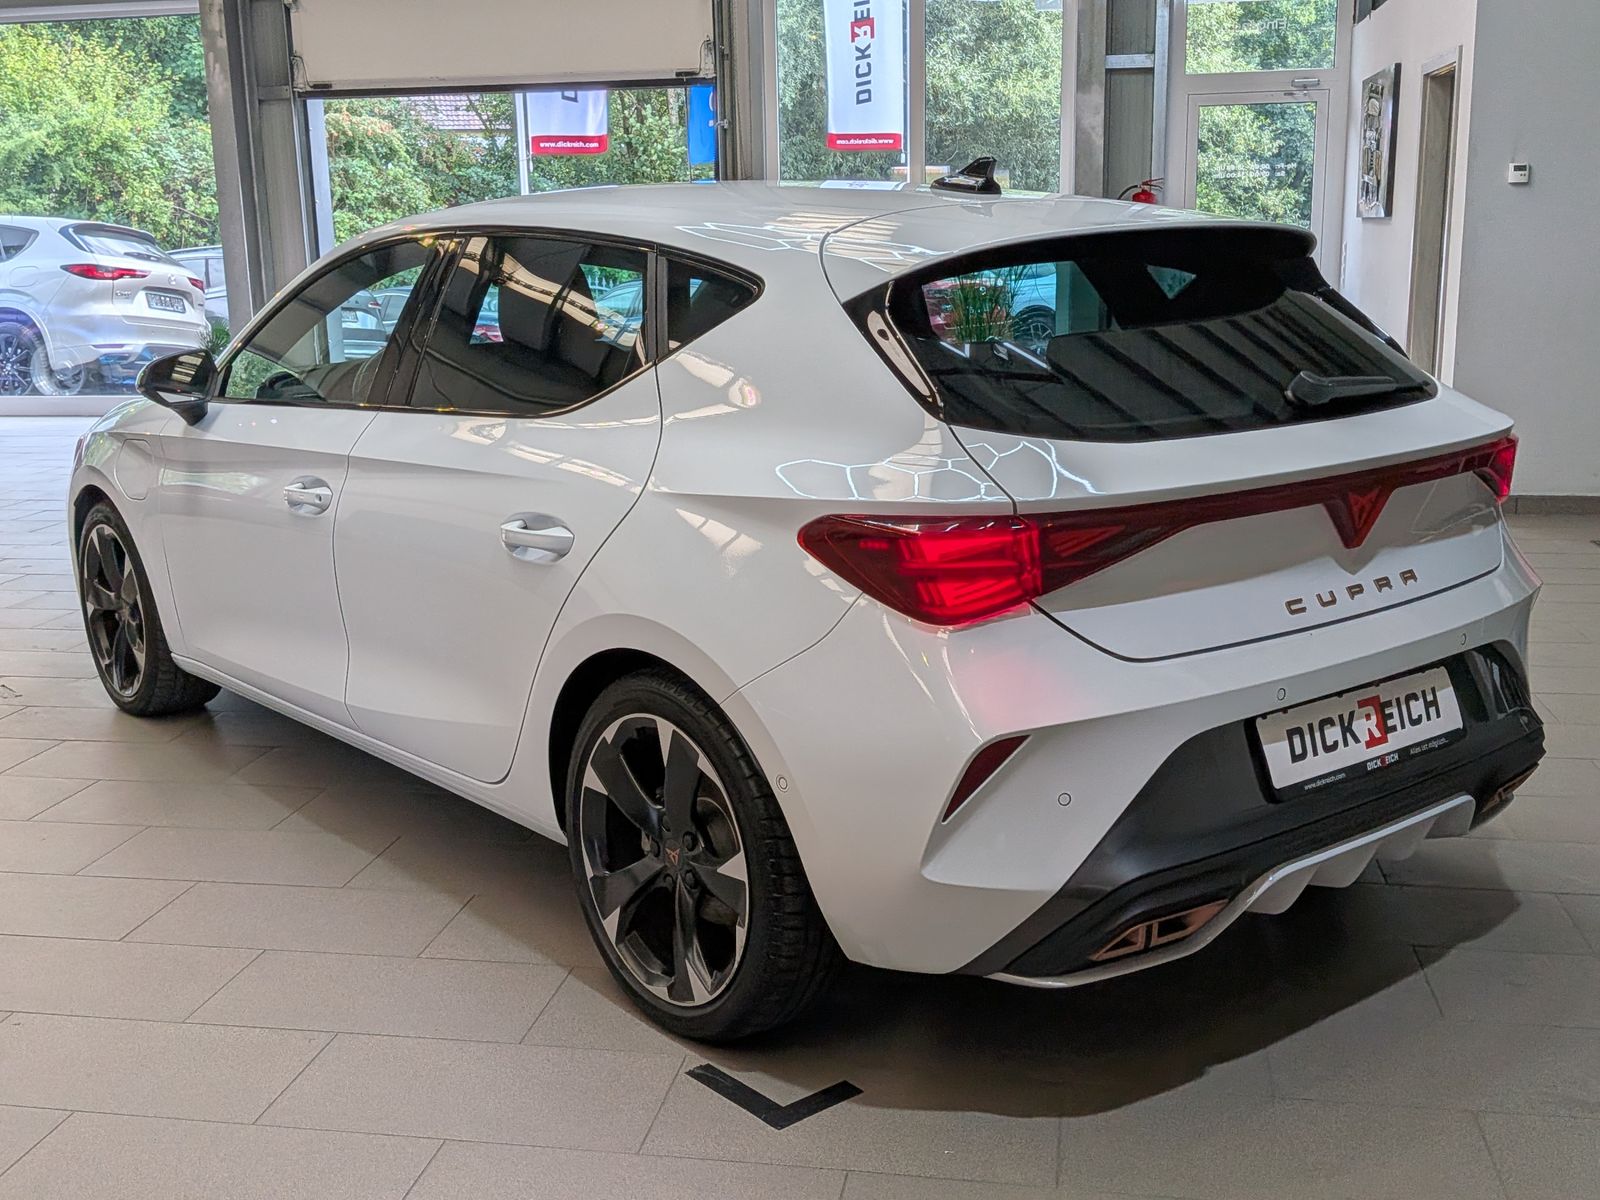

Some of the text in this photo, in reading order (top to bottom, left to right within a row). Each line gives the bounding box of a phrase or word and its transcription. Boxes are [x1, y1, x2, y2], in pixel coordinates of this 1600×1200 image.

[539, 140, 600, 148] www.dickreich.com
[1285, 568, 1419, 615] CUPRA
[1285, 686, 1441, 764] DICKREICH
